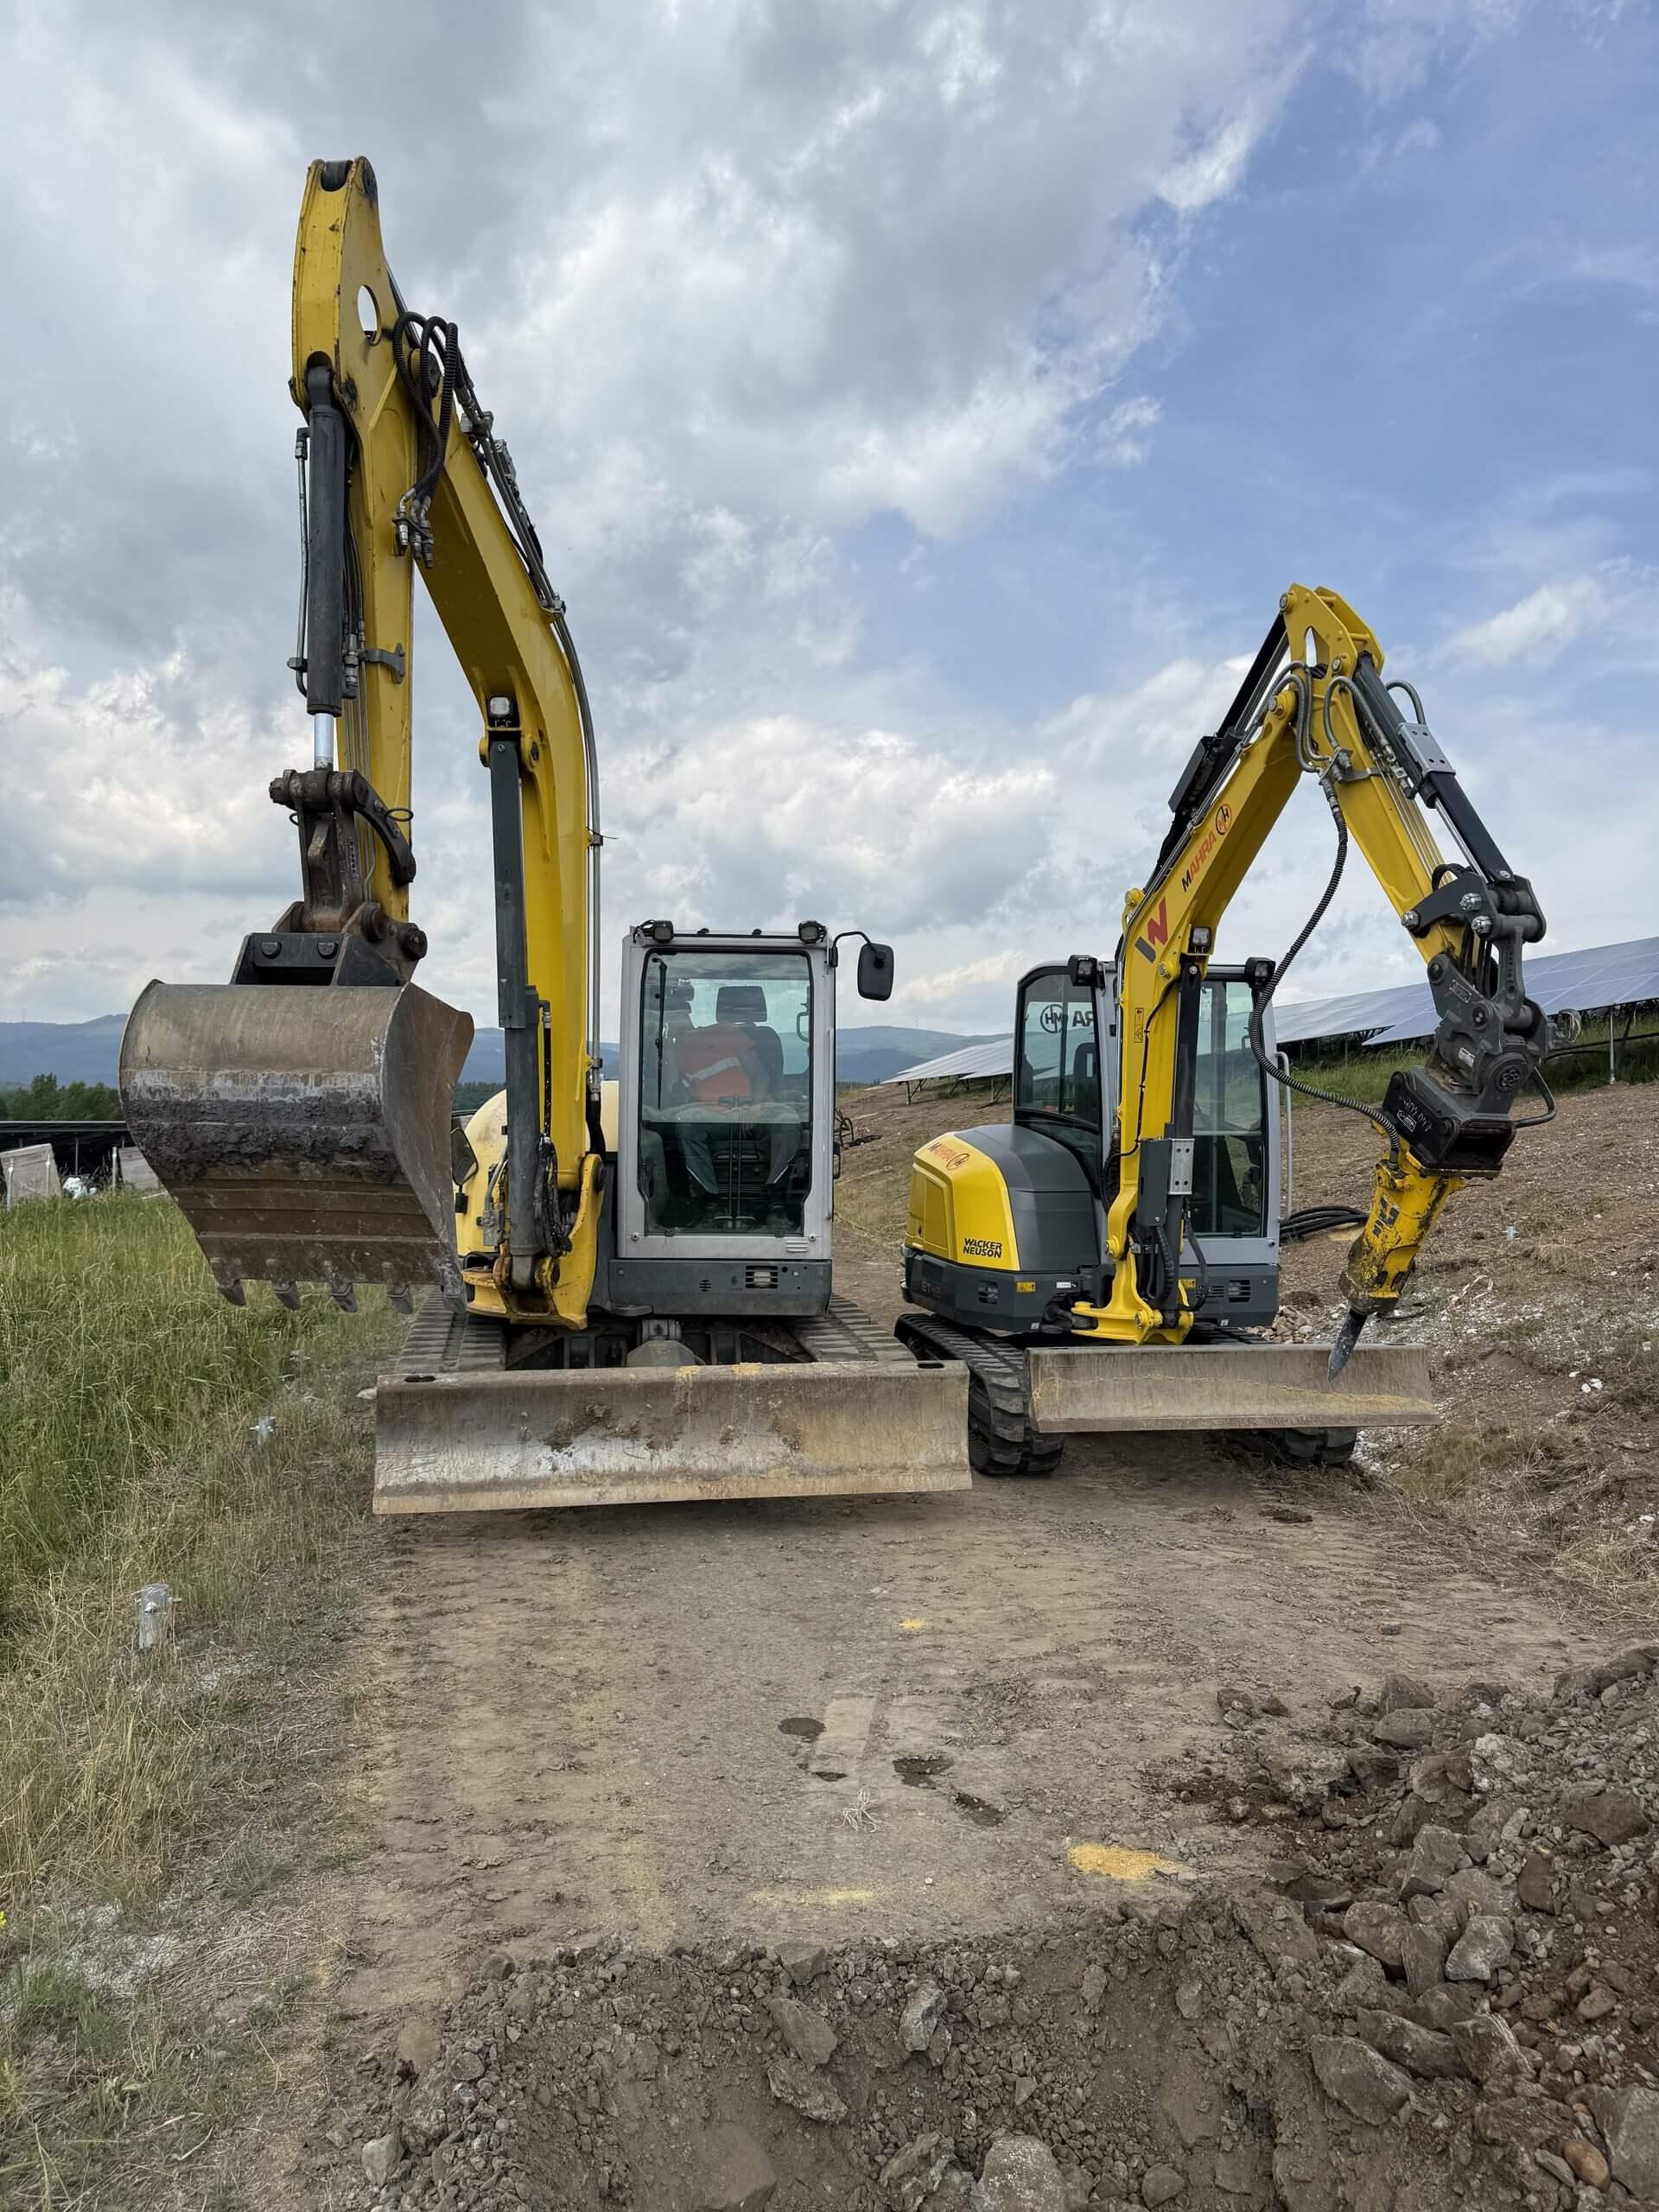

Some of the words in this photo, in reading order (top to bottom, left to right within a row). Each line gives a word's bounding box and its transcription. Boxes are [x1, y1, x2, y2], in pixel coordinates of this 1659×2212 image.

[1181, 831, 1217, 893] MAHRA
[964, 1238, 1002, 1250] WACKER
[963, 1246, 1002, 1258] NEUSON
